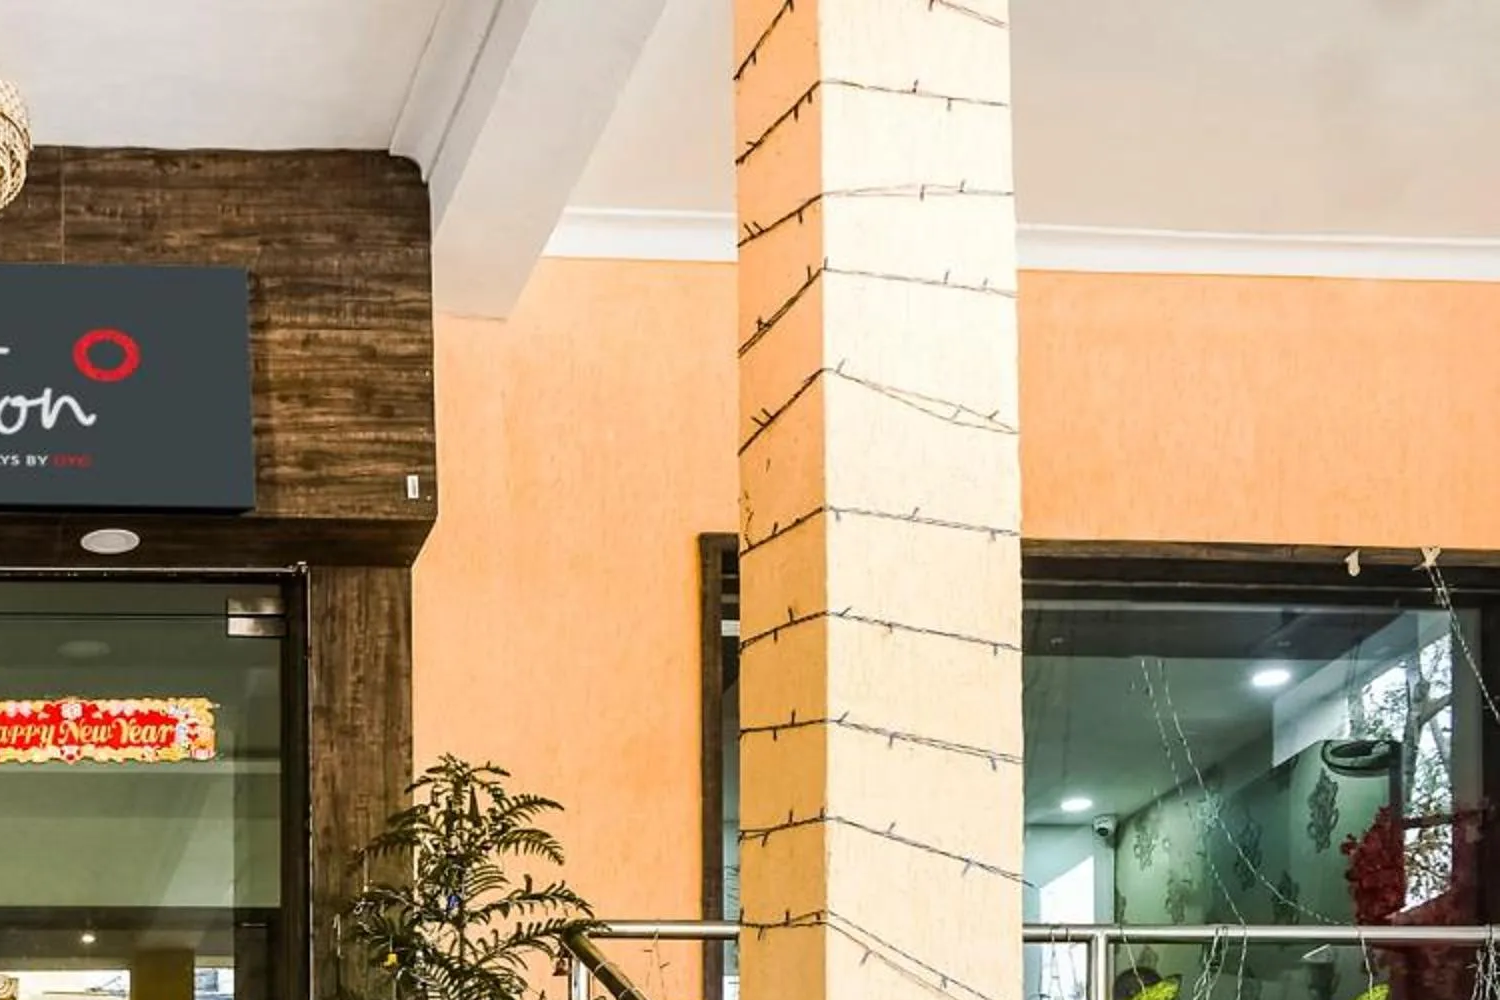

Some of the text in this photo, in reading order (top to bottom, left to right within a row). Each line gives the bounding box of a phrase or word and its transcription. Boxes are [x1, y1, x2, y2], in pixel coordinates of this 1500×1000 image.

[25, 454, 49, 467] BY
[59, 717, 113, 746] New
[112, 716, 176, 746] Year
